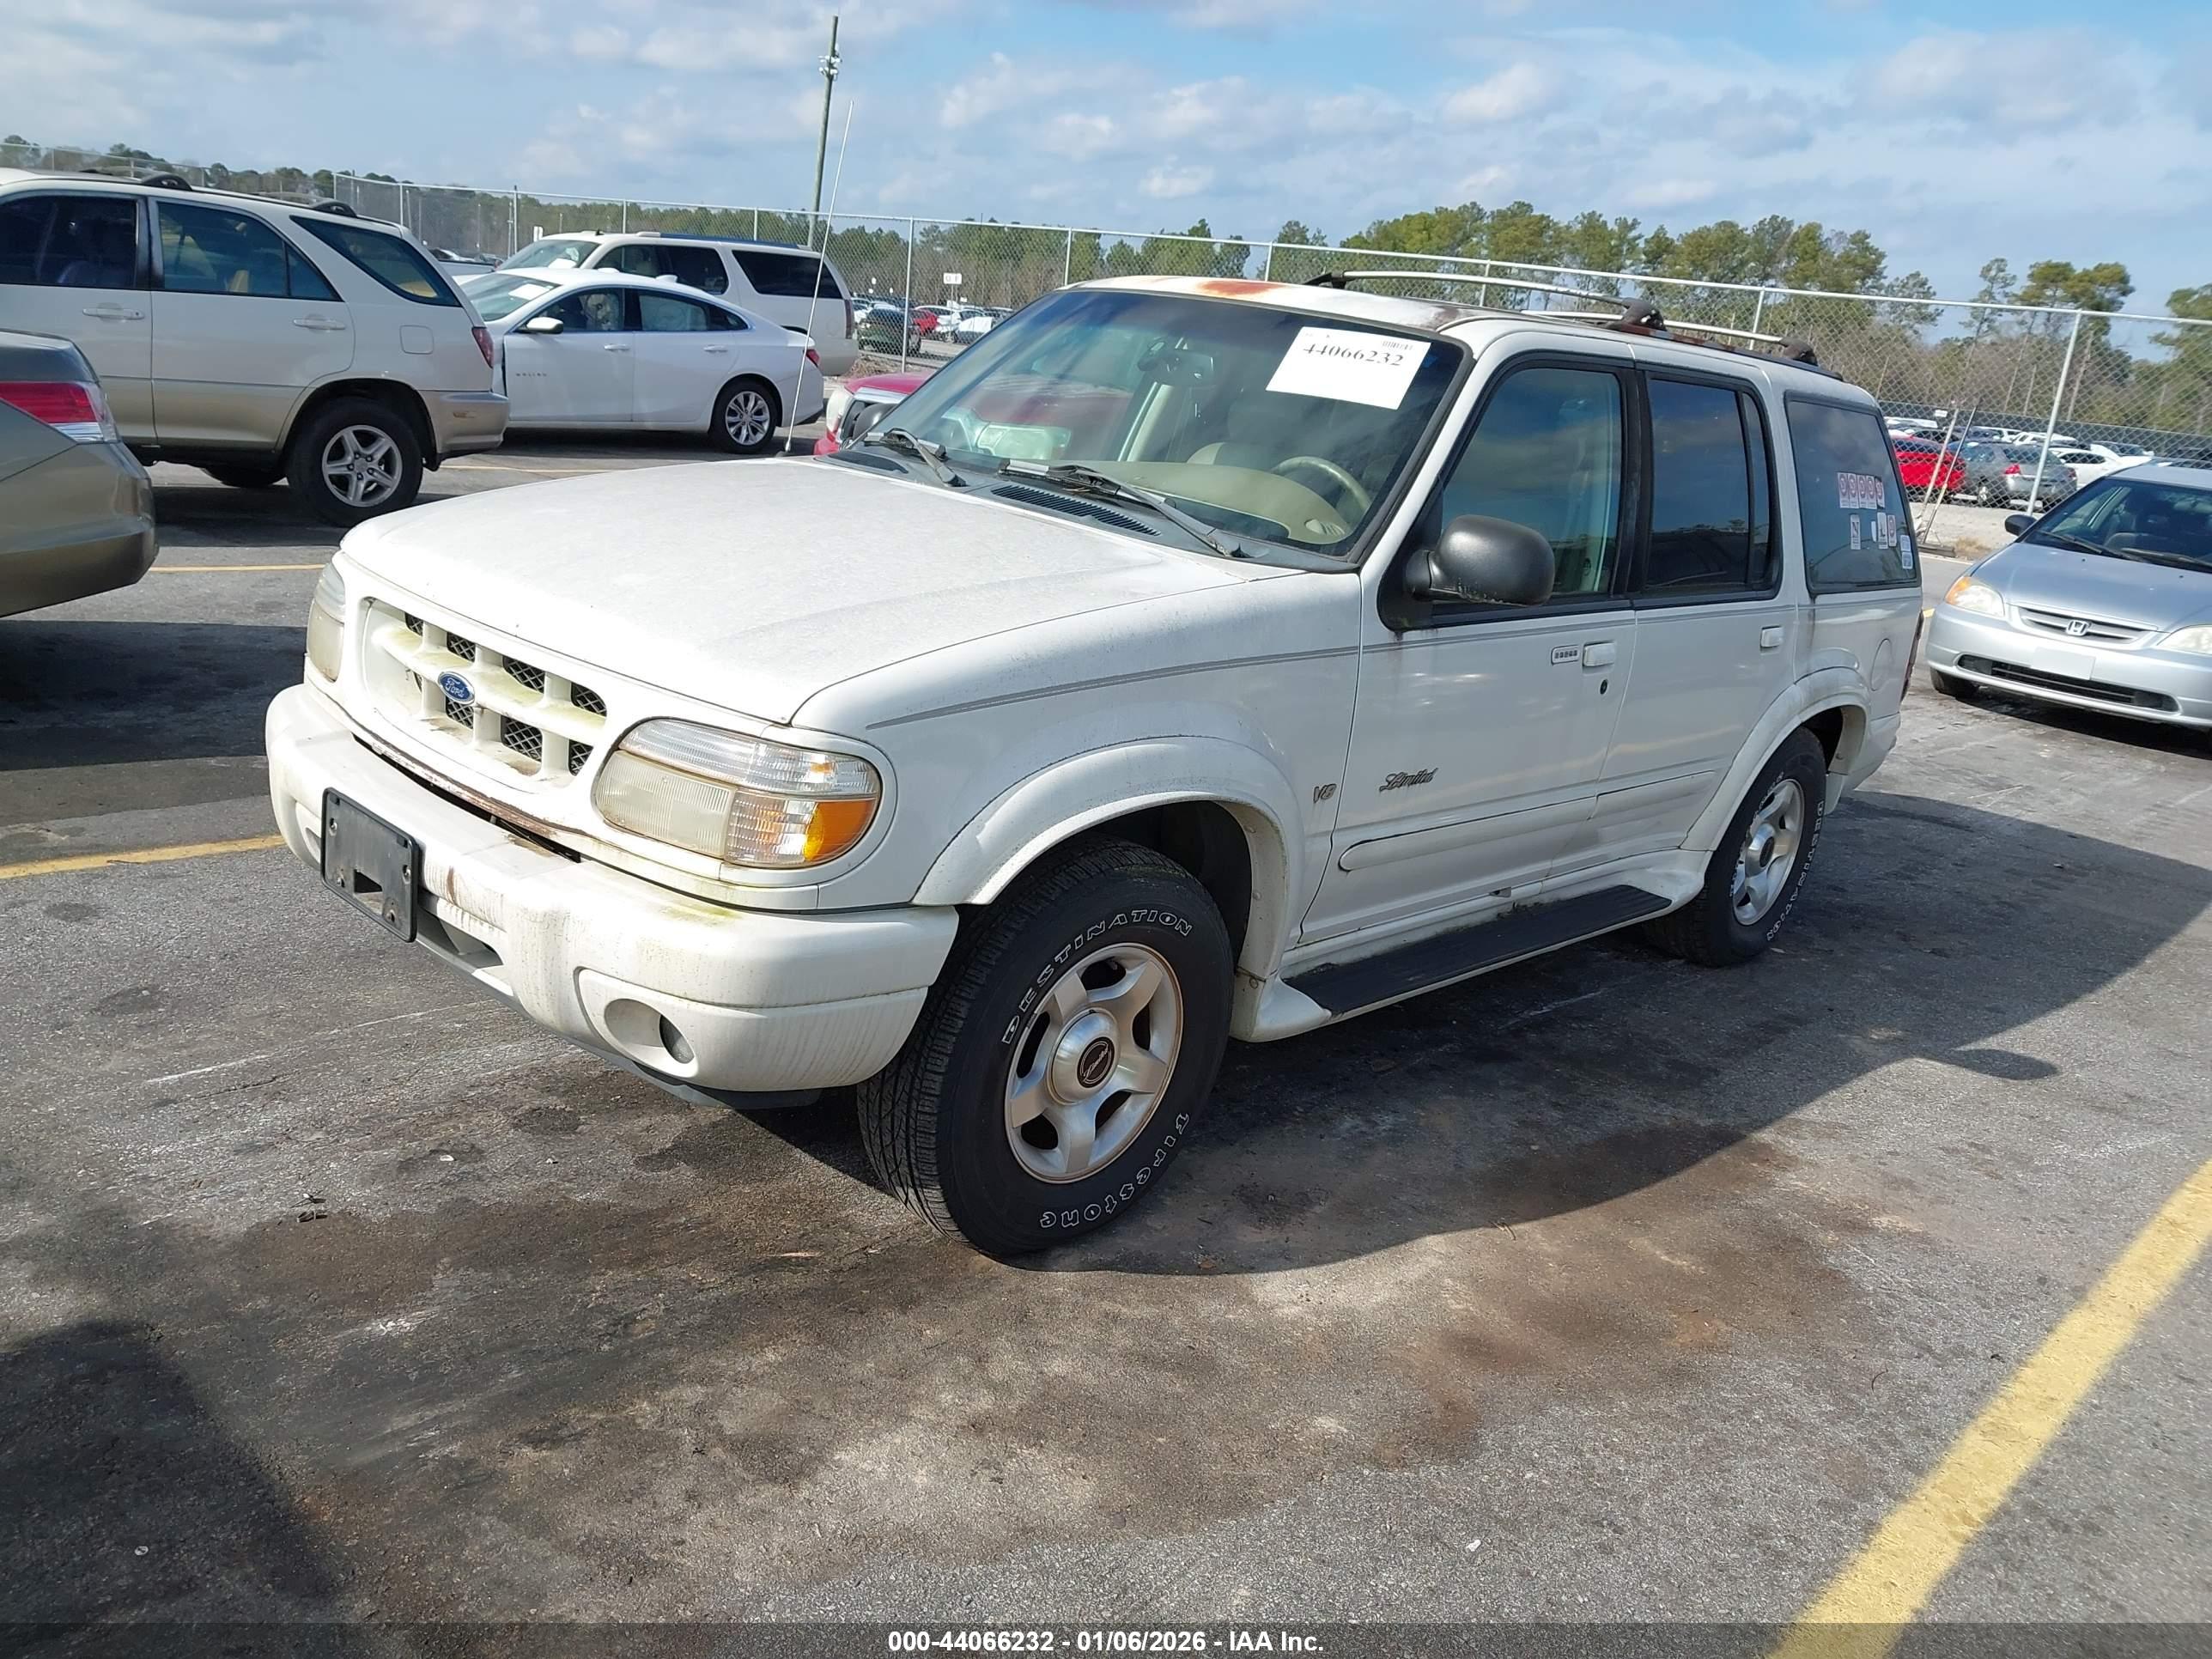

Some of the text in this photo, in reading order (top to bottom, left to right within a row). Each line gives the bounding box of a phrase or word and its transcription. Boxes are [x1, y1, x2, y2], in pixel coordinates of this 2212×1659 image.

[1303, 343, 1404, 367] 44066232
[445, 677, 465, 698] Ford
[1378, 768, 1439, 793] Limited
[1313, 783, 1337, 804] V8
[1001, 908, 1193, 1045] DESTINATION
[1039, 1113, 1189, 1229] Firestone
